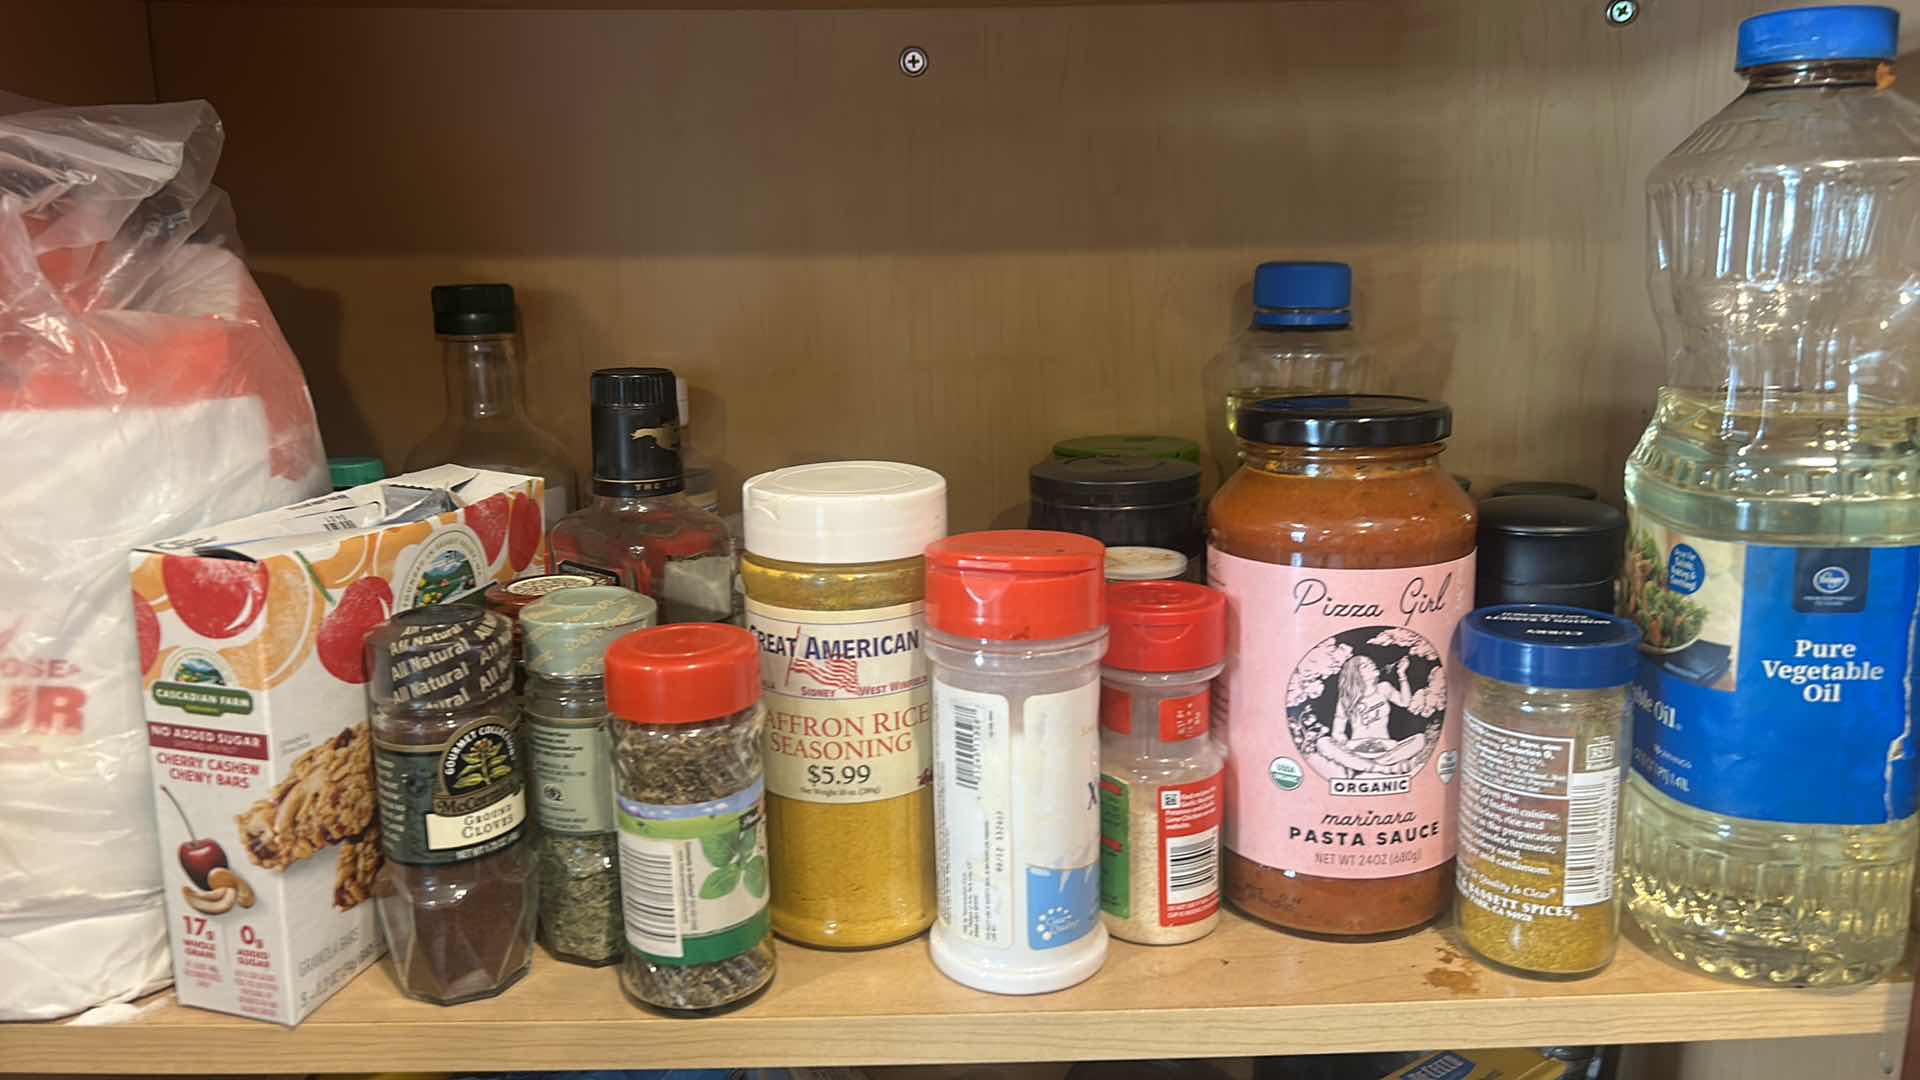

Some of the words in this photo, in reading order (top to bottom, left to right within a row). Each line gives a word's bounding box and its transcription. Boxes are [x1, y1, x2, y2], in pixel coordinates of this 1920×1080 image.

[1293, 578, 1384, 616] Pizza
[1400, 572, 1453, 627] Girl
[409, 637, 472, 673] Natural
[805, 629, 920, 661] AMERICAN
[1794, 639, 1857, 659] Pure
[409, 661, 470, 698] Natural
[479, 666, 499, 692] All
[1761, 660, 1886, 685] Vegetable
[154, 687, 218, 705] CASCADIAN
[219, 696, 251, 706] FARM
[1802, 684, 1842, 703] Oil
[765, 709, 864, 739] AFFRON
[872, 703, 930, 736] RICE
[150, 725, 171, 737] NO
[173, 729, 216, 743] ADDED
[217, 732, 261, 748] SUGAR
[769, 731, 913, 761] SEASONING
[156, 751, 203, 768] CHERRY
[206, 757, 260, 776] CASHEW
[444, 730, 477, 775] GOURMET
[168, 766, 212, 785] CHEWY
[215, 773, 250, 789] BARS
[807, 765, 871, 785] $5.99
[1333, 779, 1409, 794] ORGANIC
[461, 815, 514, 839] CLOVES
[463, 803, 513, 827] GROUND
[1320, 808, 1417, 827] marinara
[1289, 825, 1365, 846] PASTA
[1376, 820, 1440, 845] SAUCE
[1315, 851, 1337, 865] NET
[1339, 854, 1358, 866] WT
